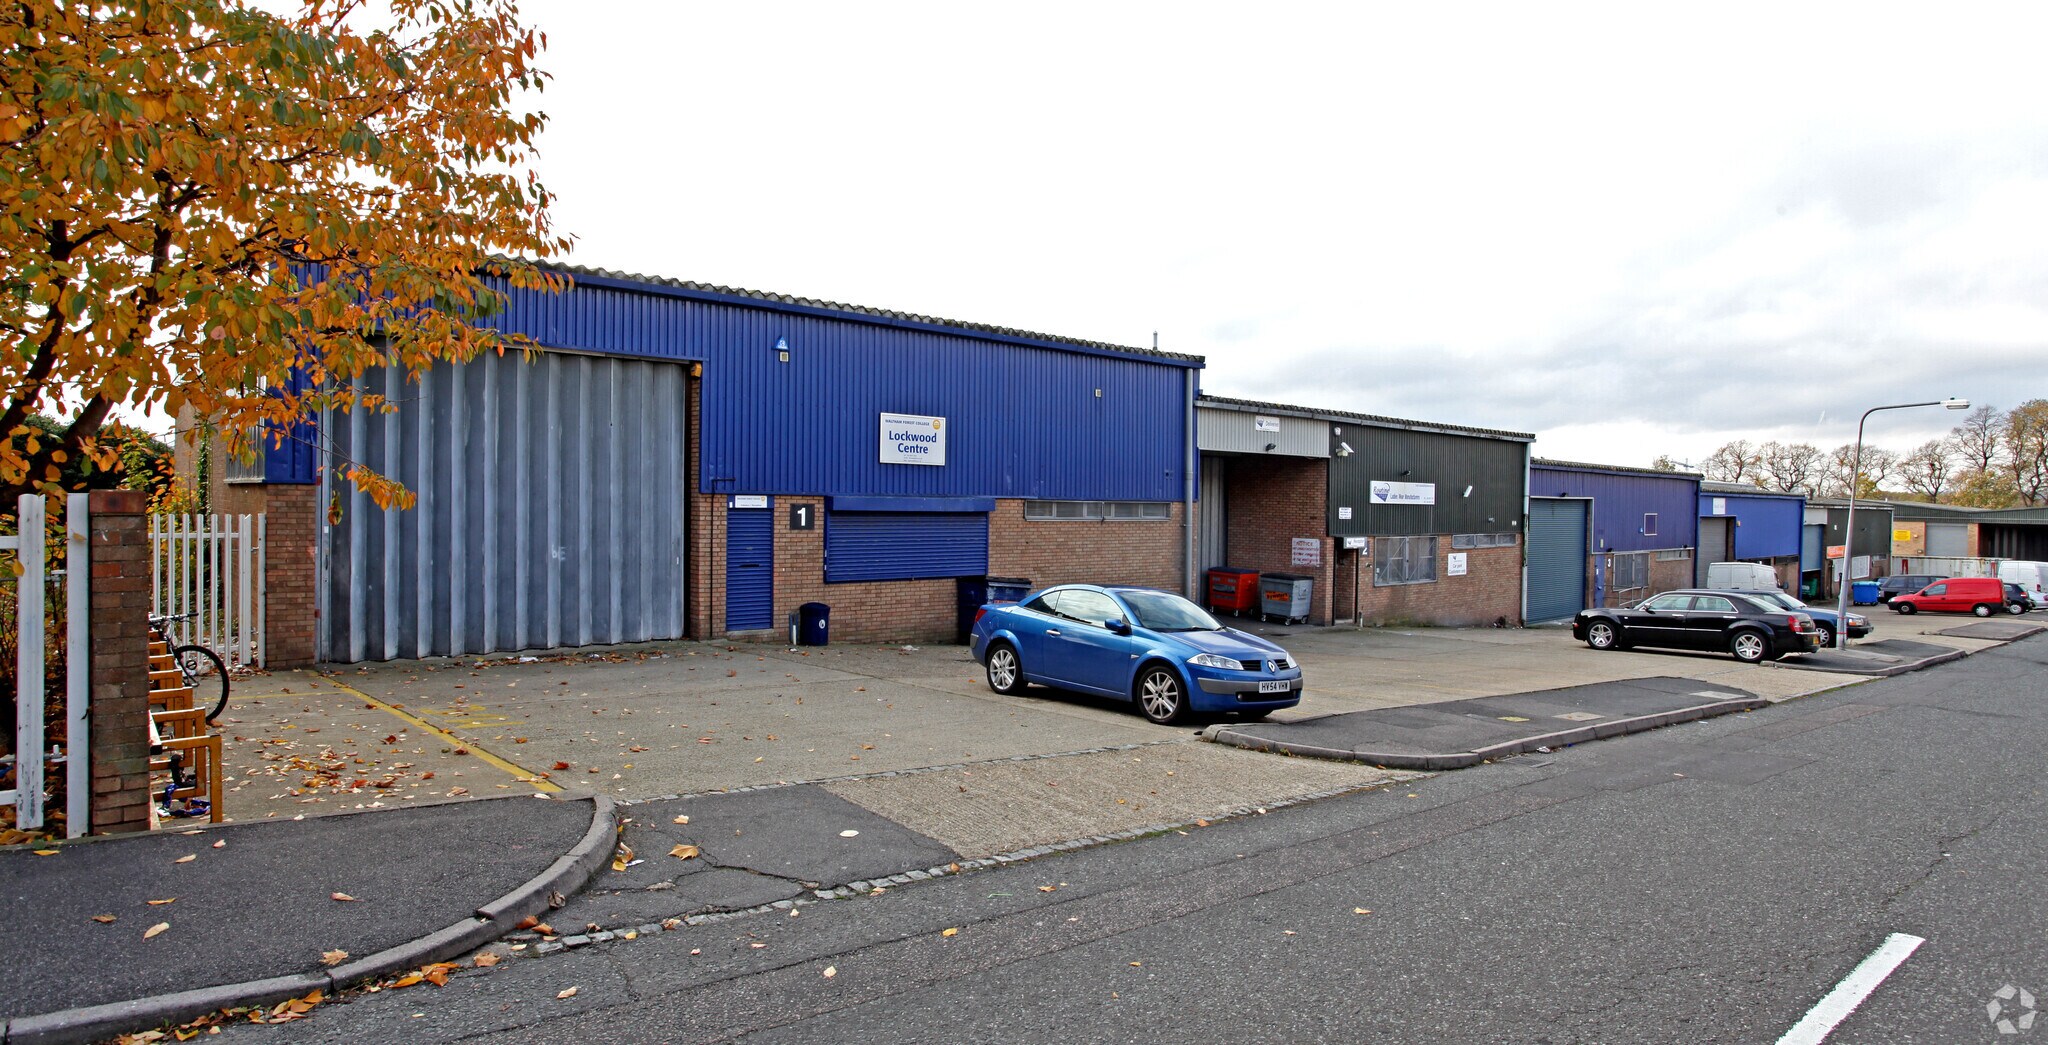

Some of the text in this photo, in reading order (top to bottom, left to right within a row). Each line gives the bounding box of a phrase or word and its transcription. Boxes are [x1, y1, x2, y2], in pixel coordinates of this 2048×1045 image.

[889, 430, 937, 443] Lockwood
[897, 443, 928, 454] Centre
[797, 507, 806, 526] 1
[1362, 547, 1368, 555] 2
